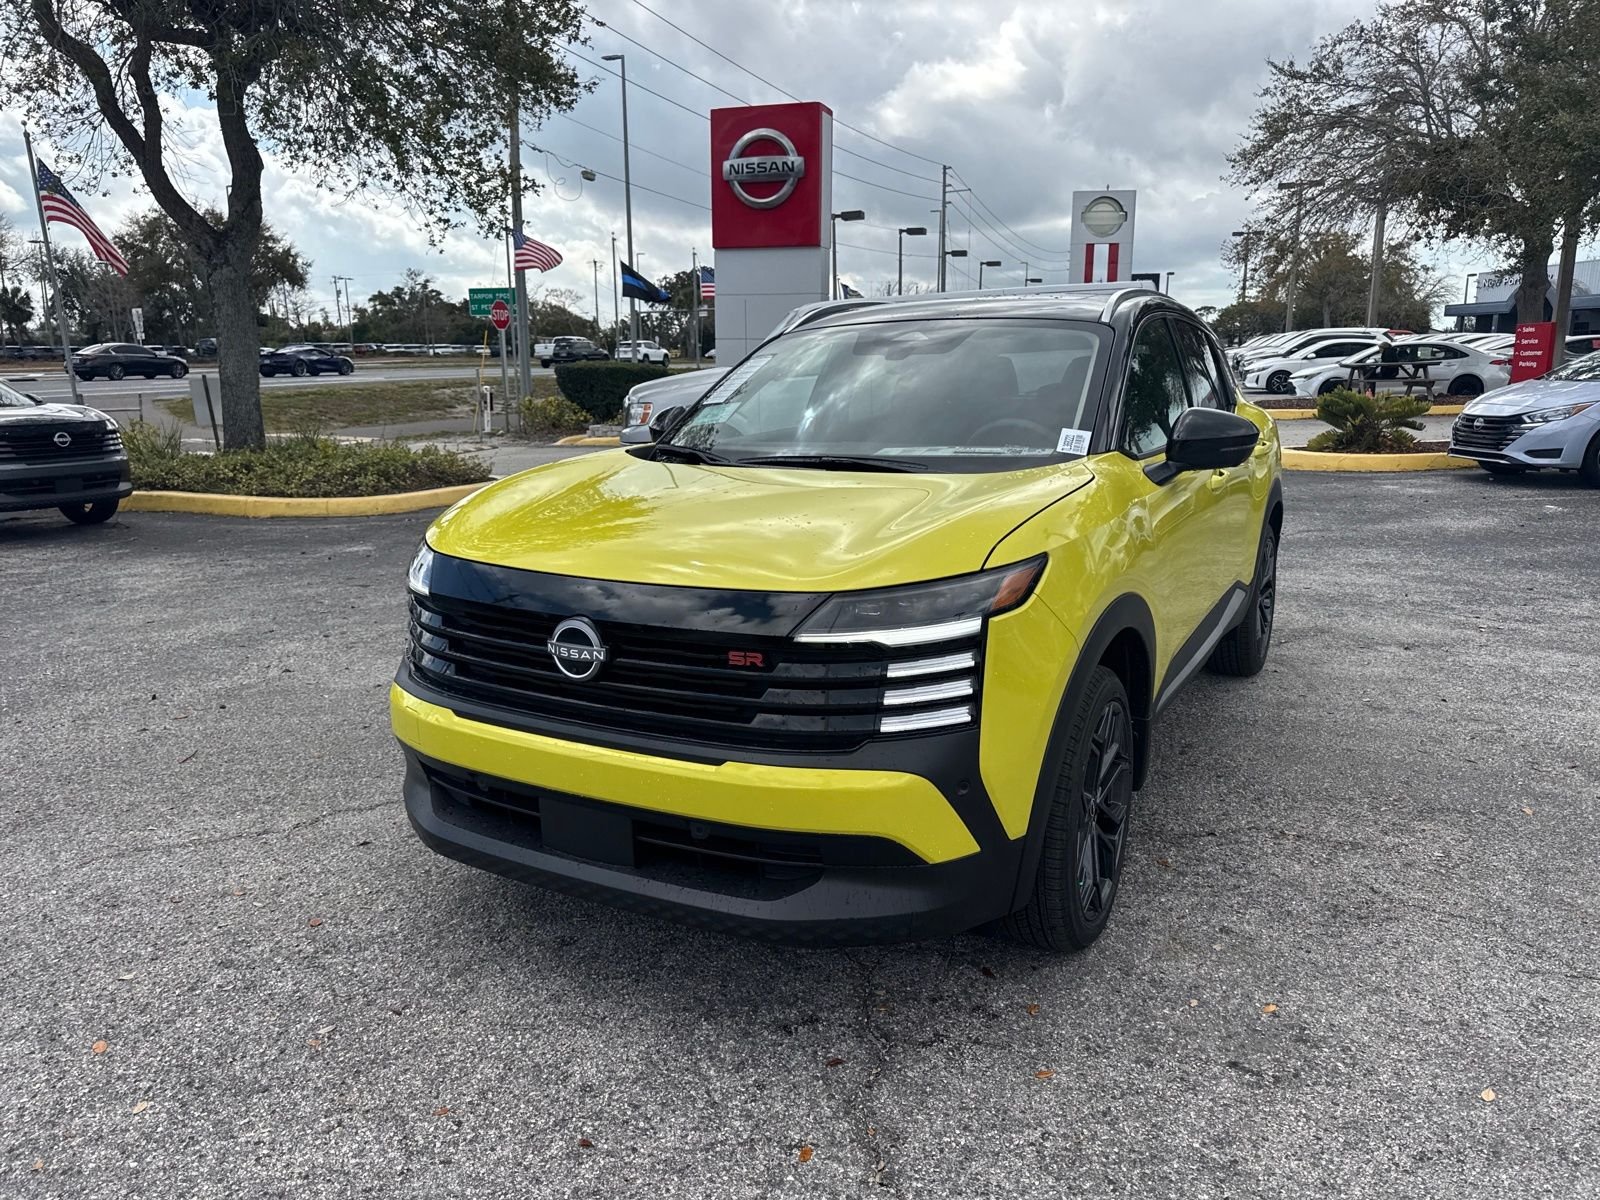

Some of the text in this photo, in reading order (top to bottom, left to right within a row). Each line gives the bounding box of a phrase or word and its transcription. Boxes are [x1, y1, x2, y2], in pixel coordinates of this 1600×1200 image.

[729, 161, 795, 175] NISSAN
[492, 309, 508, 321] STOP
[547, 643, 604, 660] NISSAN
[728, 651, 764, 667] SR
